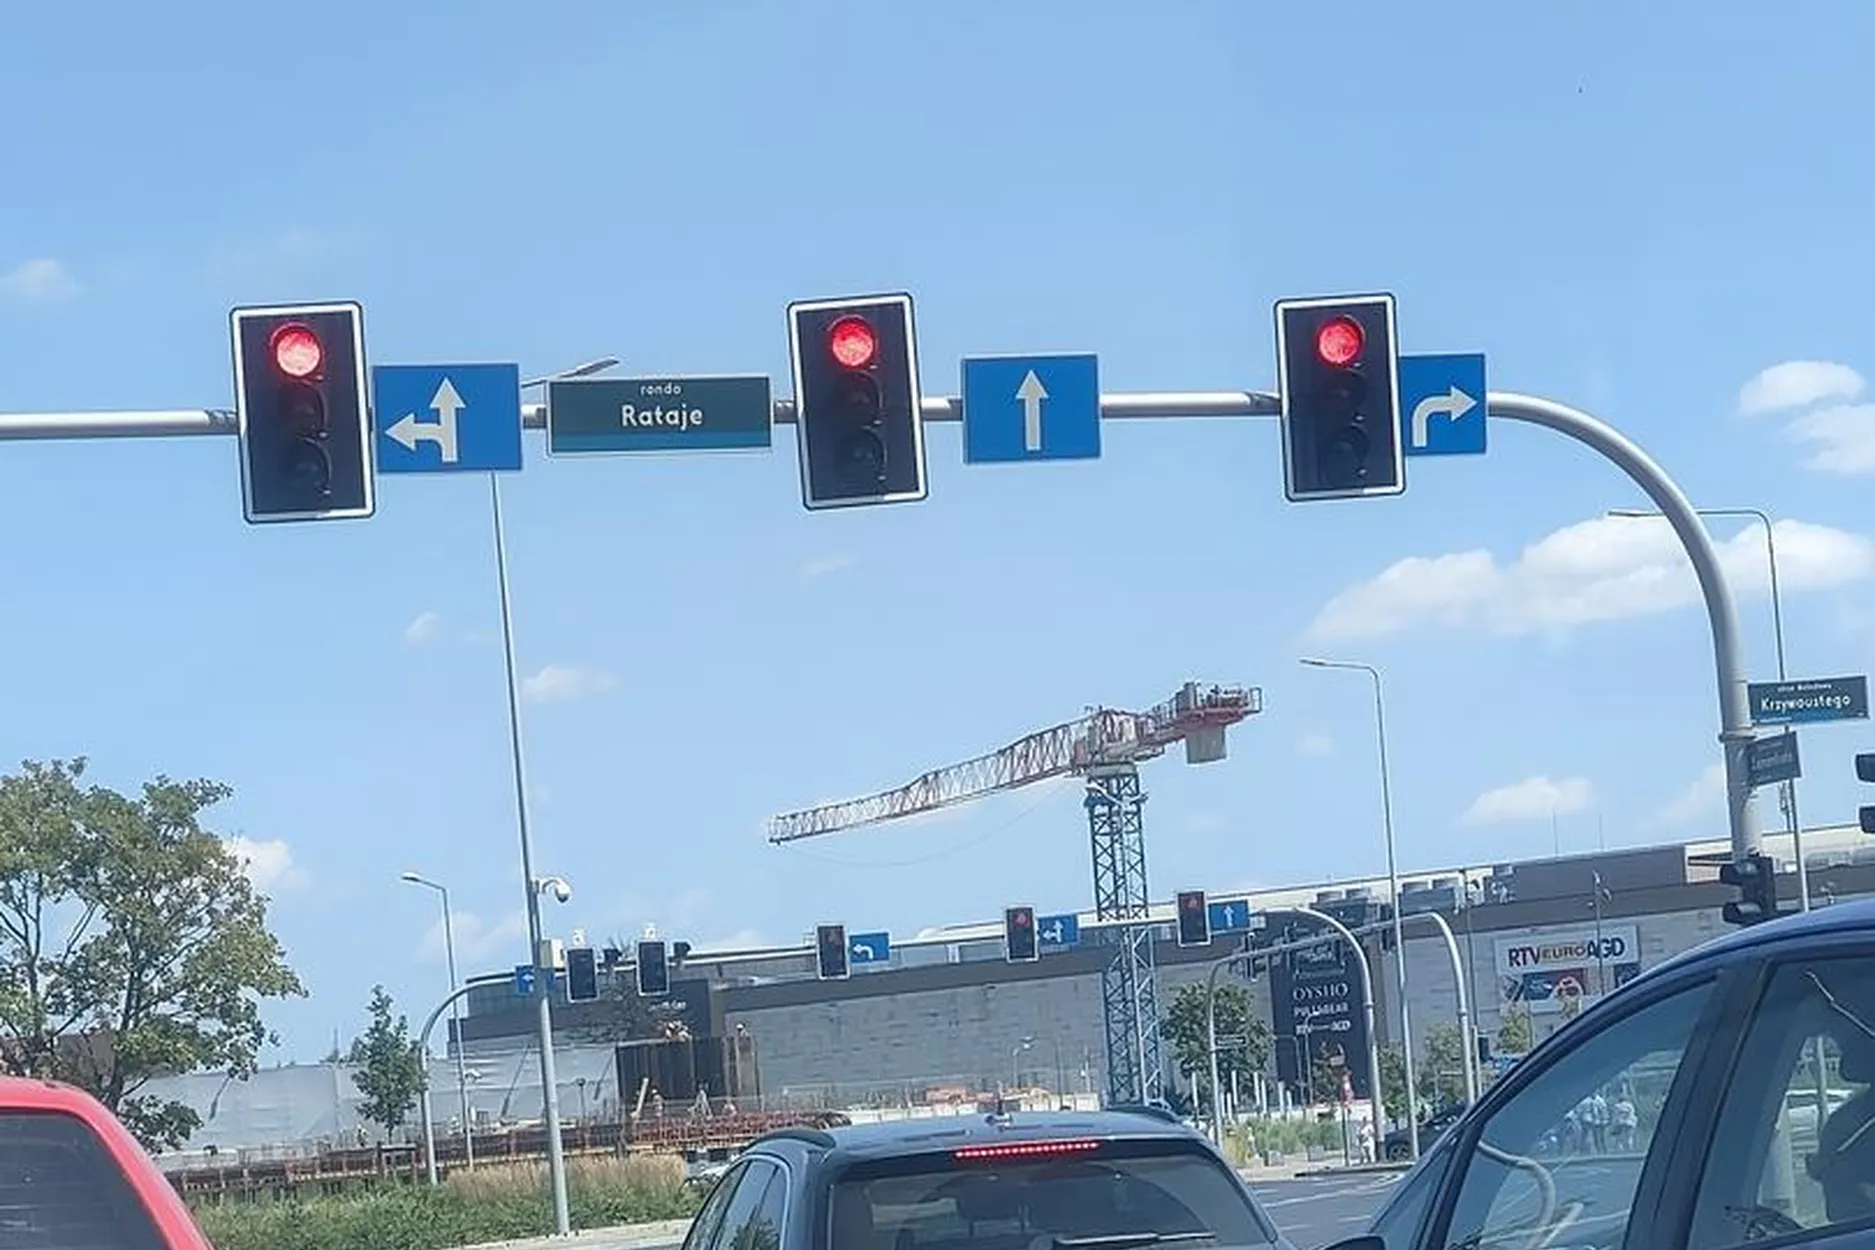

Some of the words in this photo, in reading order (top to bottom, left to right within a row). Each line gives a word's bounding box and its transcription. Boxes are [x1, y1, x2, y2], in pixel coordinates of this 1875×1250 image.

[640, 382, 682, 396] rondo
[622, 403, 703, 431] Rataje
[1761, 695, 1851, 714] Krzywoustego
